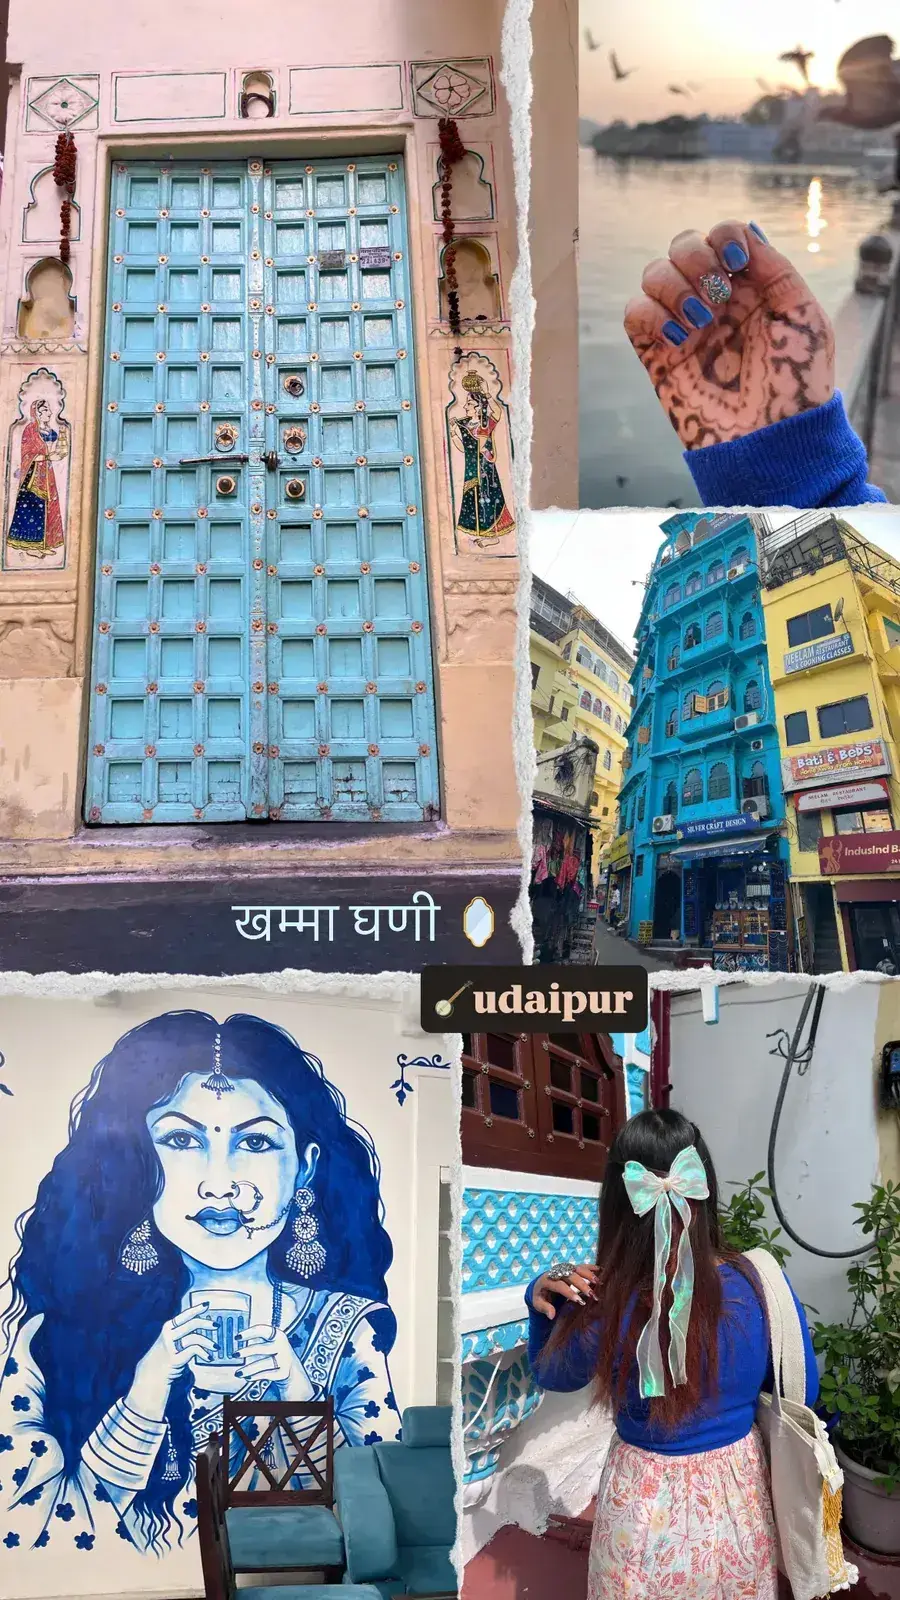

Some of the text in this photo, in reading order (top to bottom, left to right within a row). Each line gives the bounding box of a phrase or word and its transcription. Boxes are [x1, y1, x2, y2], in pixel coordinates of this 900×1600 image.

[784, 646, 815, 664] NEELAM
[816, 639, 849, 656] RESTAURANT
[800, 654, 826, 668] COOKING
[826, 645, 852, 659] CLASSES
[797, 755, 823, 769] Bati
[687, 823, 706, 834] SILVER
[706, 821, 724, 831] CRAFT
[726, 818, 746, 828] DESIGN
[844, 844, 890, 856] IndusInd
